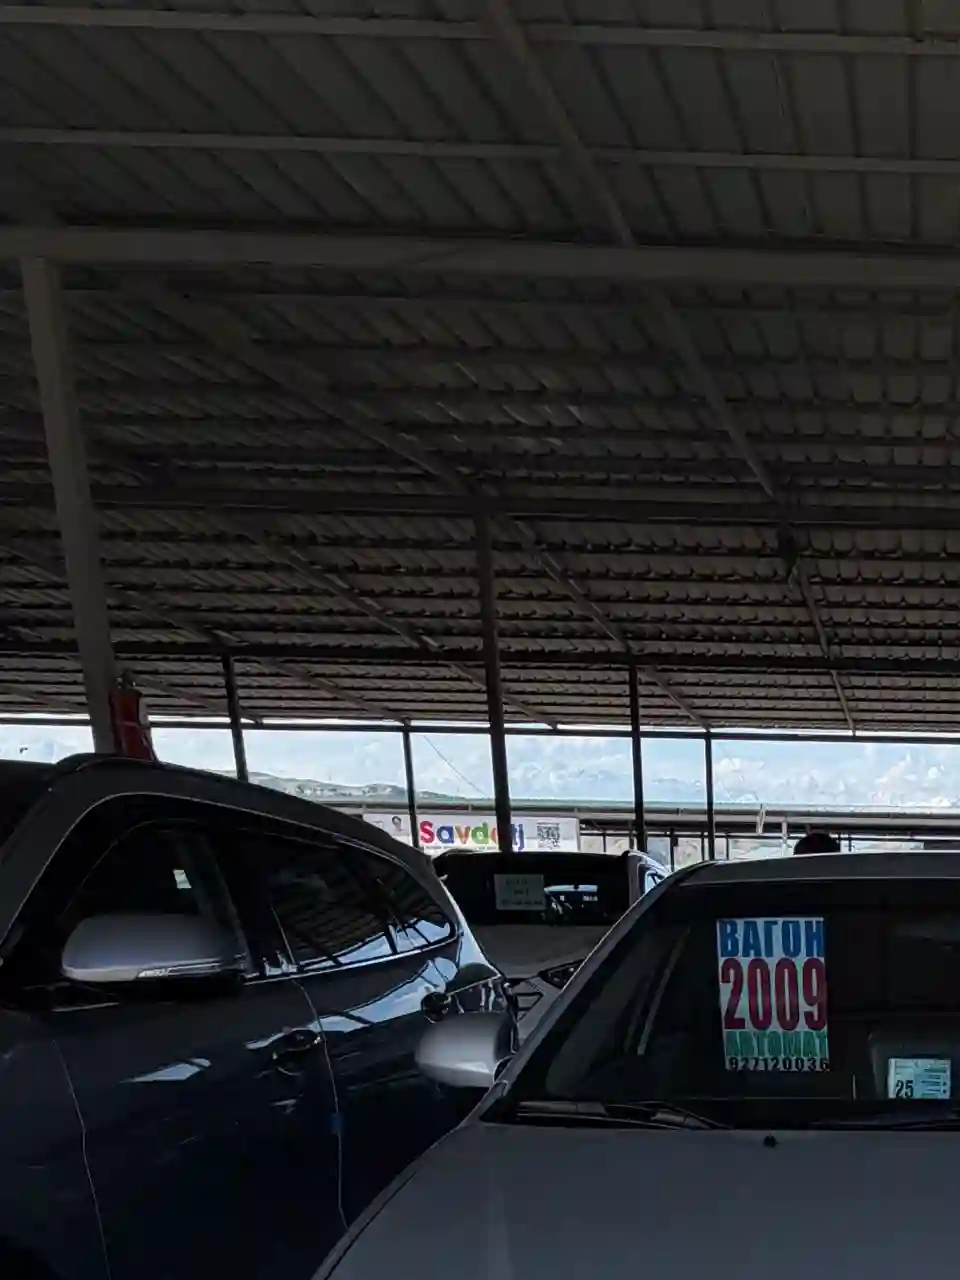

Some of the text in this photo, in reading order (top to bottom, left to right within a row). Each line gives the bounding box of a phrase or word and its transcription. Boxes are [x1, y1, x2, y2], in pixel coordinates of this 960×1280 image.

[419, 820, 525, 851] Savdtj
[719, 920, 826, 957] ВАГОН
[721, 958, 828, 1030] 2009
[725, 1031, 829, 1056] АВТОМАТ
[895, 1080, 914, 1098] 25
